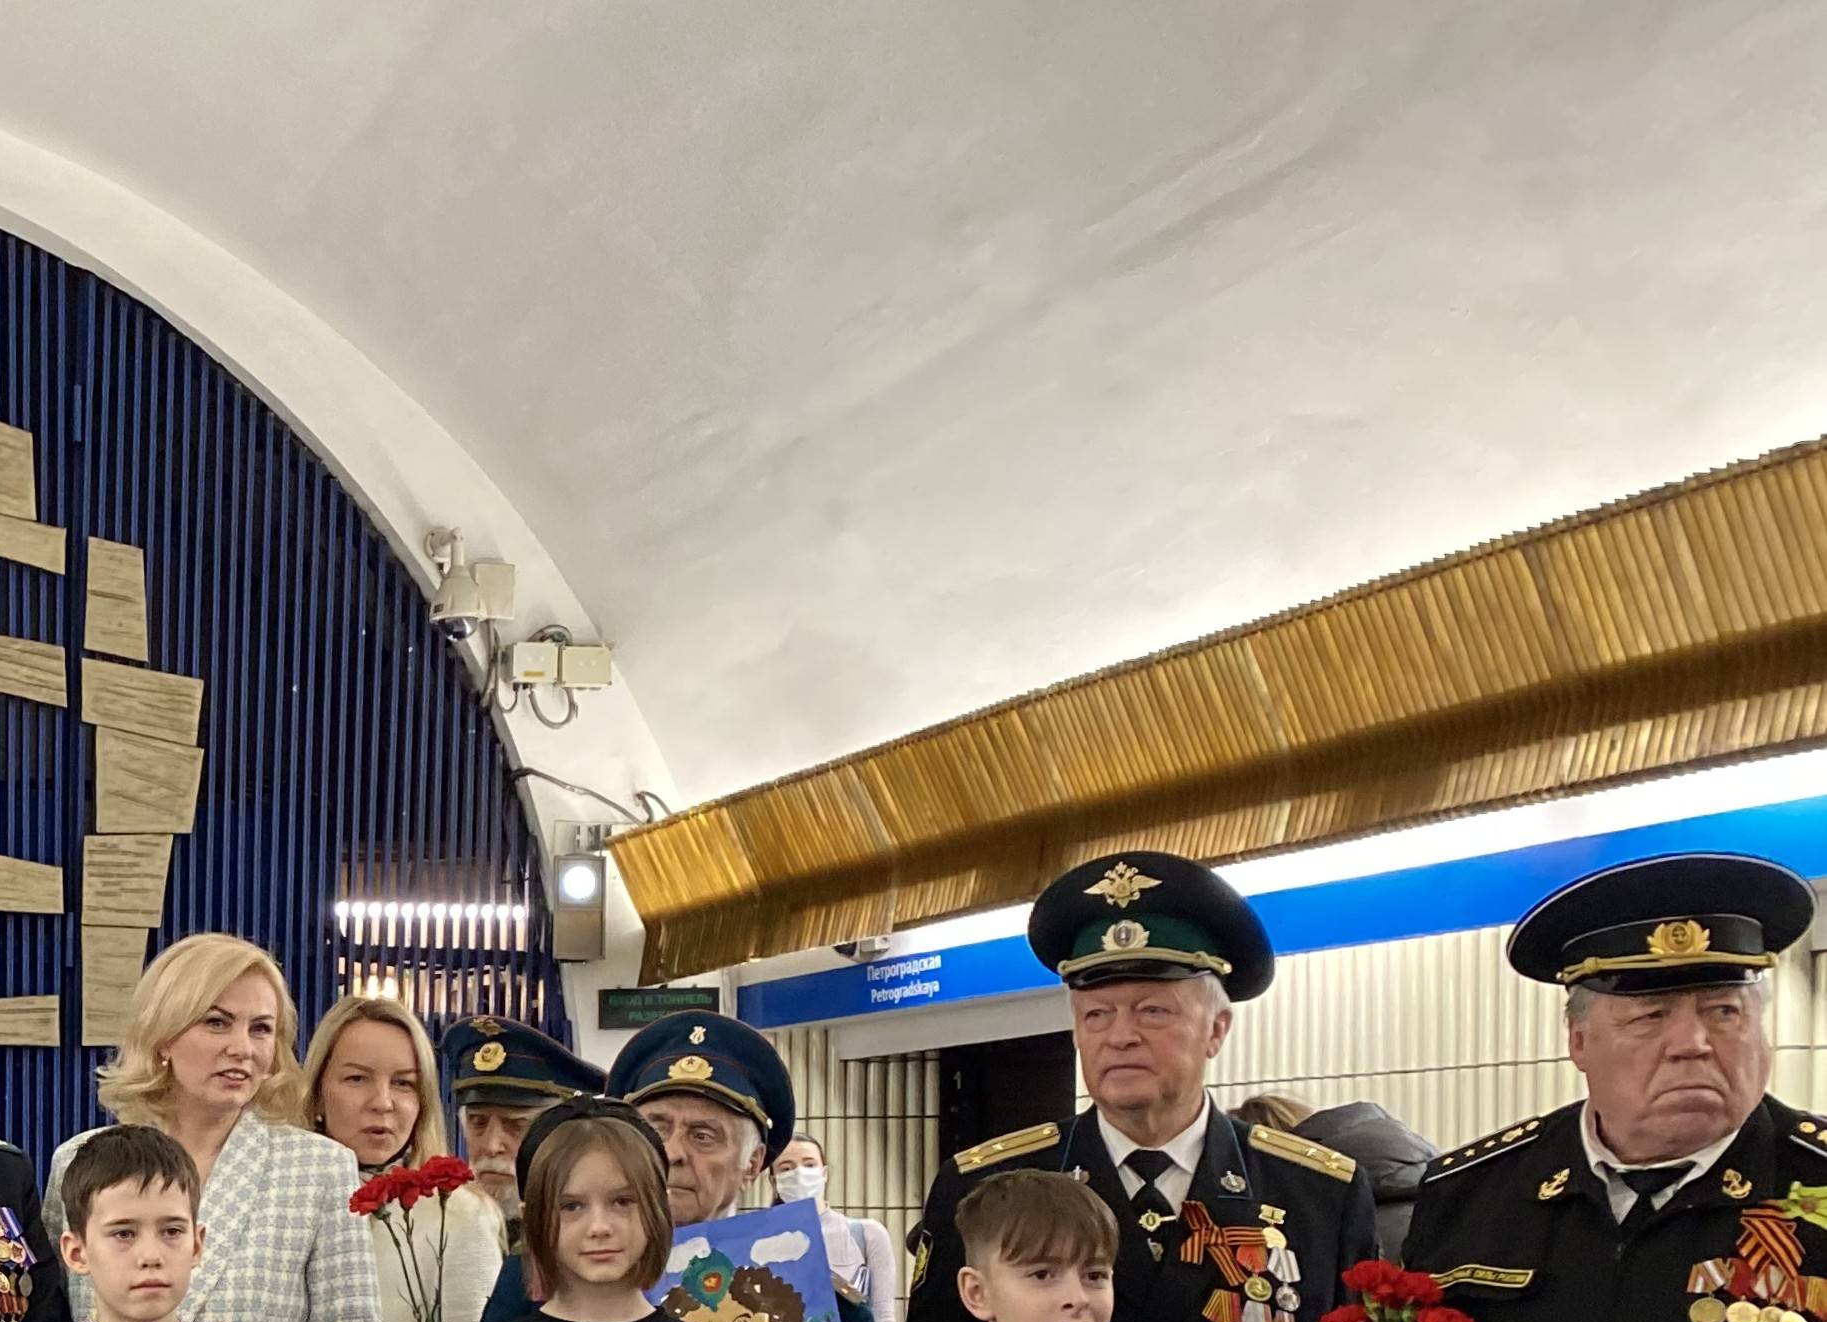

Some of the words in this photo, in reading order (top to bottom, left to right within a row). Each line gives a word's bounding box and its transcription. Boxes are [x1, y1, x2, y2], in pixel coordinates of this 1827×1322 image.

[867, 955, 942, 983] Петроградская
[871, 980, 940, 1003] Petrogradskaya
[953, 1071, 962, 1090] 1
